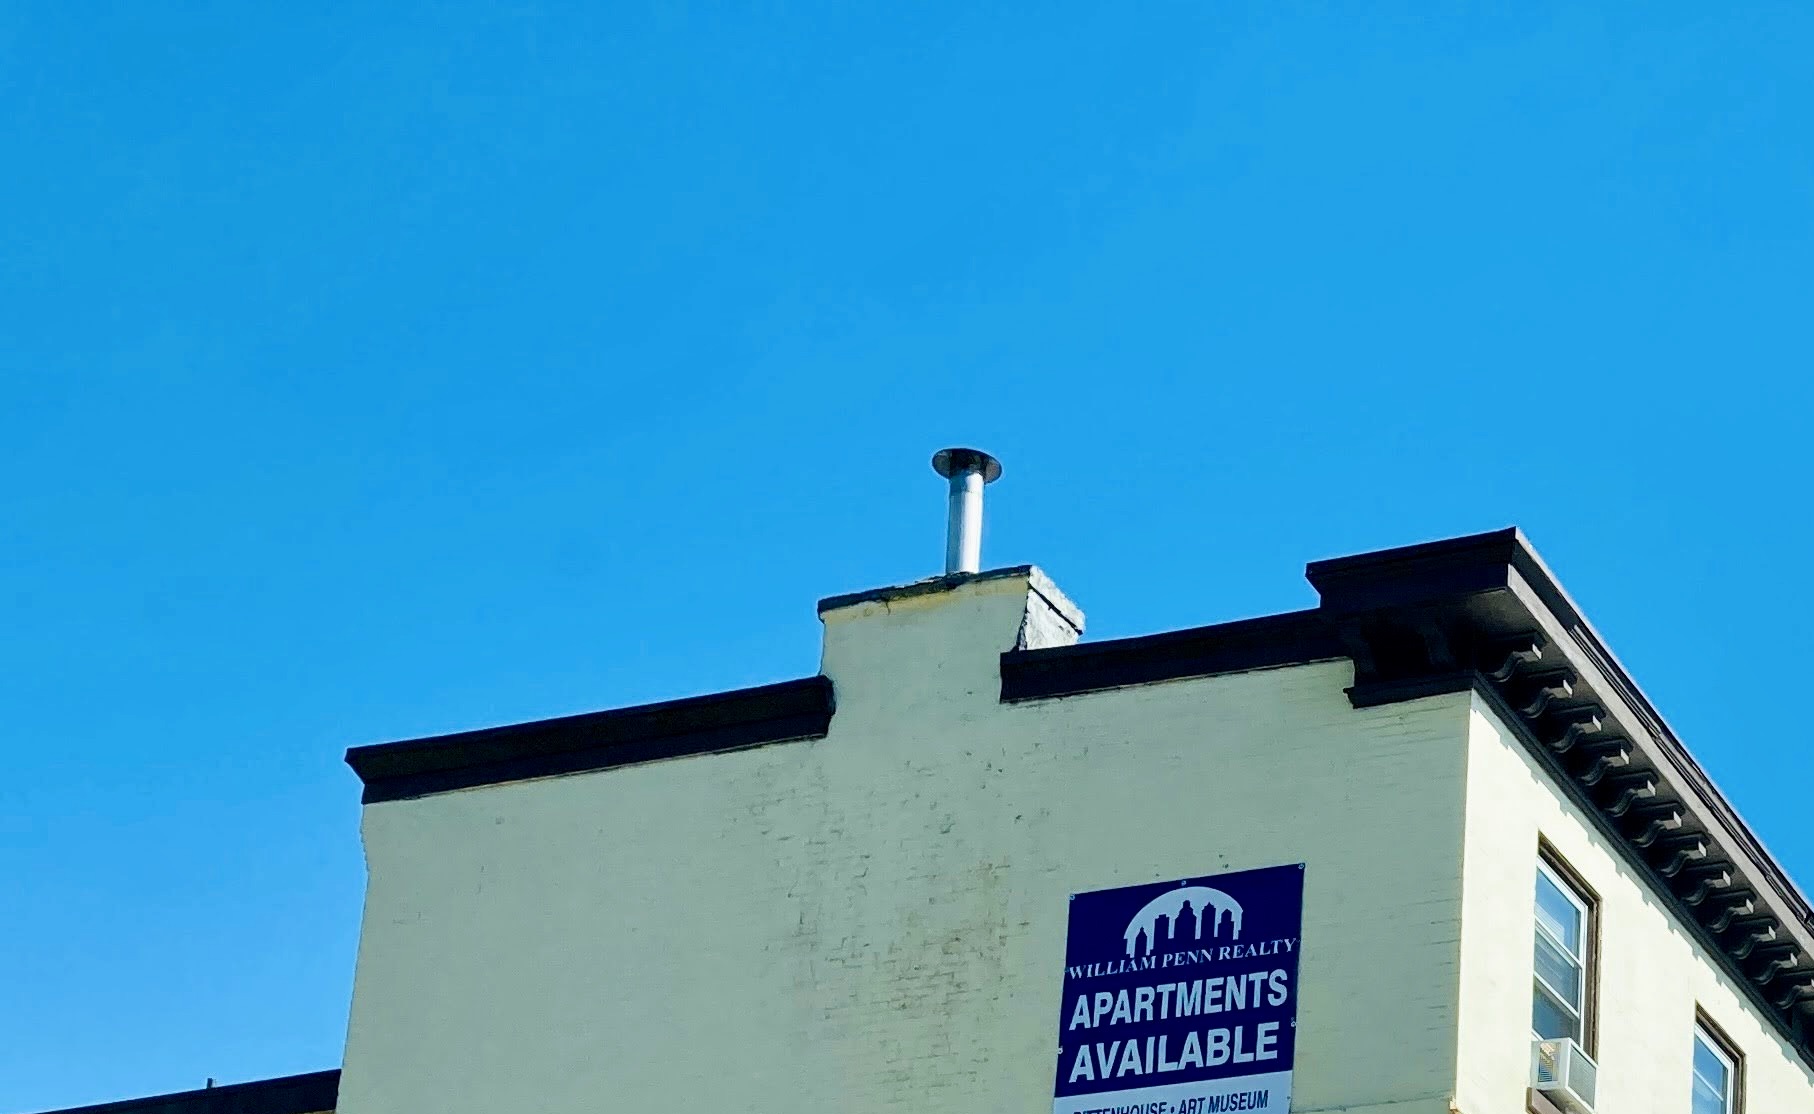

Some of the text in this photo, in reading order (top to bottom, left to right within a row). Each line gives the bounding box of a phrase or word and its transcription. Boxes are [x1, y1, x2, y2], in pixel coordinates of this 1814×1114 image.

[1068, 937, 1298, 980] WILLIAM PENN REALTY
[1068, 968, 1288, 1031] APARTMENTS
[1068, 1021, 1280, 1083] AVAILABLE
[1208, 1089, 1268, 1114] MUSEUM
